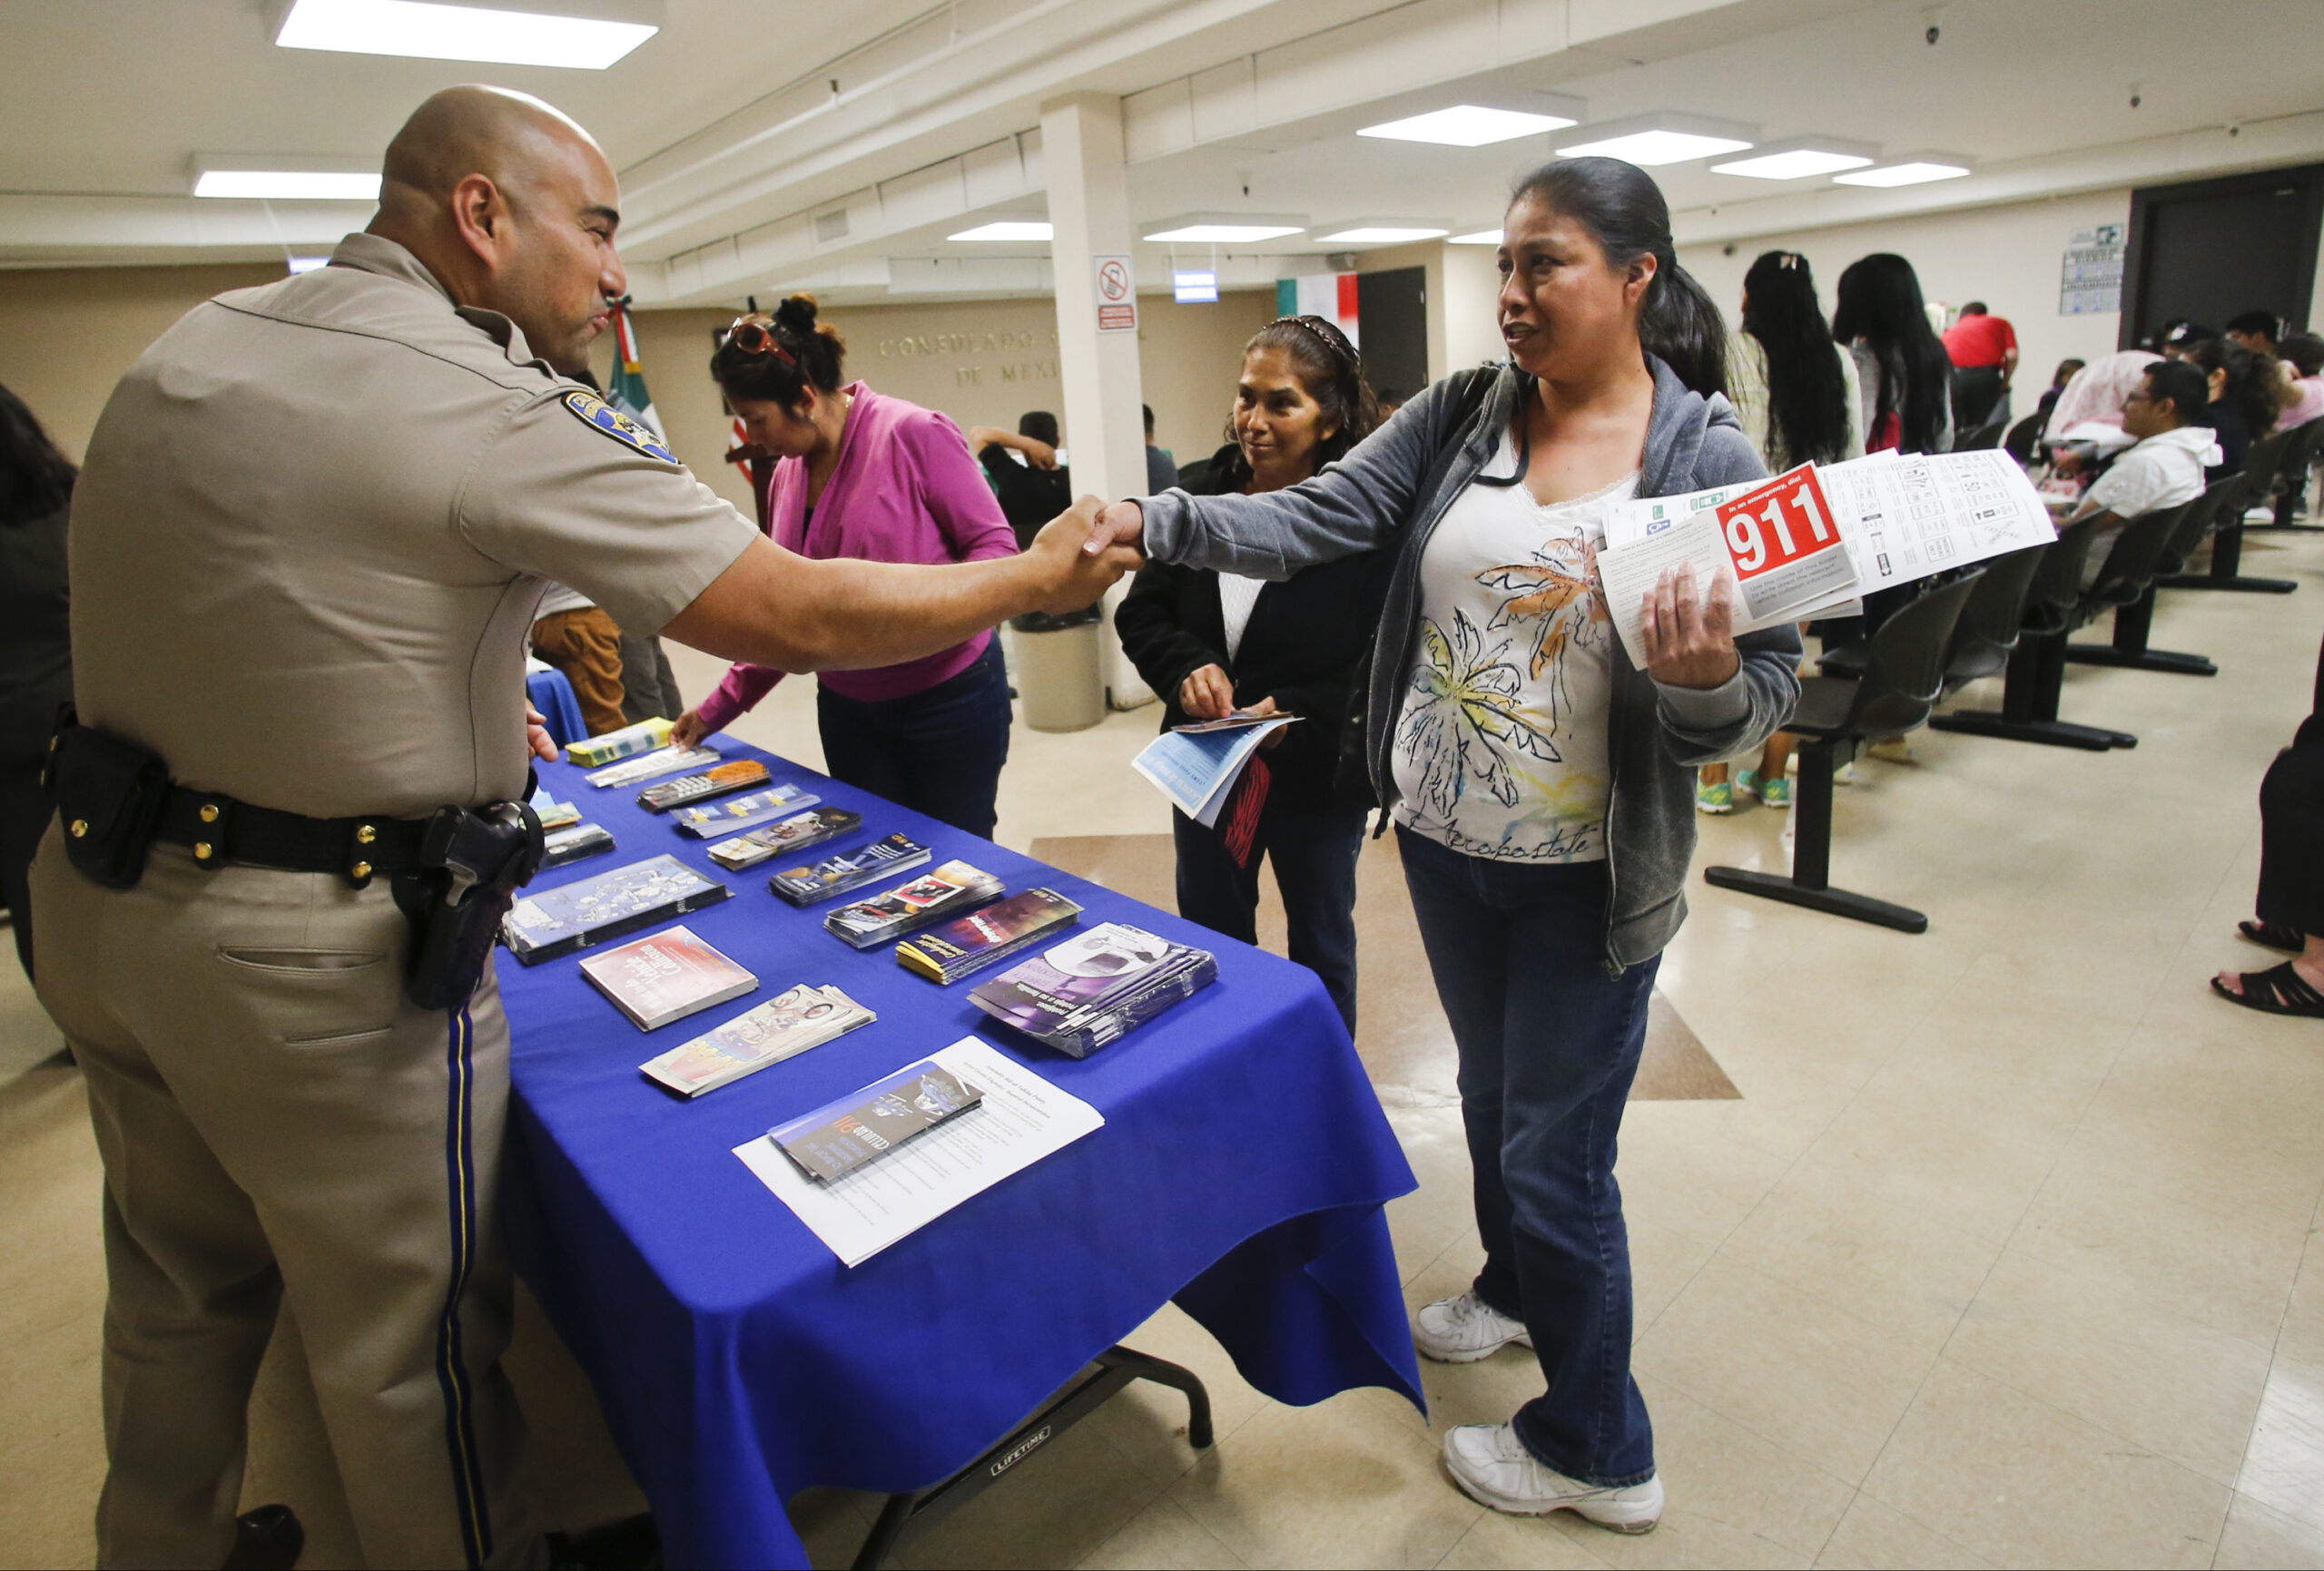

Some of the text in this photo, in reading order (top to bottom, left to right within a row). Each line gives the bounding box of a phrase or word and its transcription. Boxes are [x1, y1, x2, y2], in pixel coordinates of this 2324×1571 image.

[880, 332, 1034, 357] CONSULADO
[956, 361, 1060, 387] DE MEXI
[1728, 474, 1802, 513] In an emergency, dial
[1725, 483, 1830, 573] 911
[1748, 583, 1763, 593] Use
[1763, 577, 1775, 587] the
[1795, 565, 1805, 574] of
[1750, 591, 1760, 600] to
[1759, 584, 1777, 596] write
[1776, 576, 1797, 590] down
[1795, 572, 1808, 582] the
[1753, 591, 1777, 606] vehicle
[1777, 580, 1806, 597] collision
[617, 954, 665, 985] Vehicle
[632, 942, 685, 977] Collision
[828, 1114, 865, 1135] 911
[850, 1124, 892, 1152] CELLULAR
[995, 1429, 1047, 1471] LIFETIME
